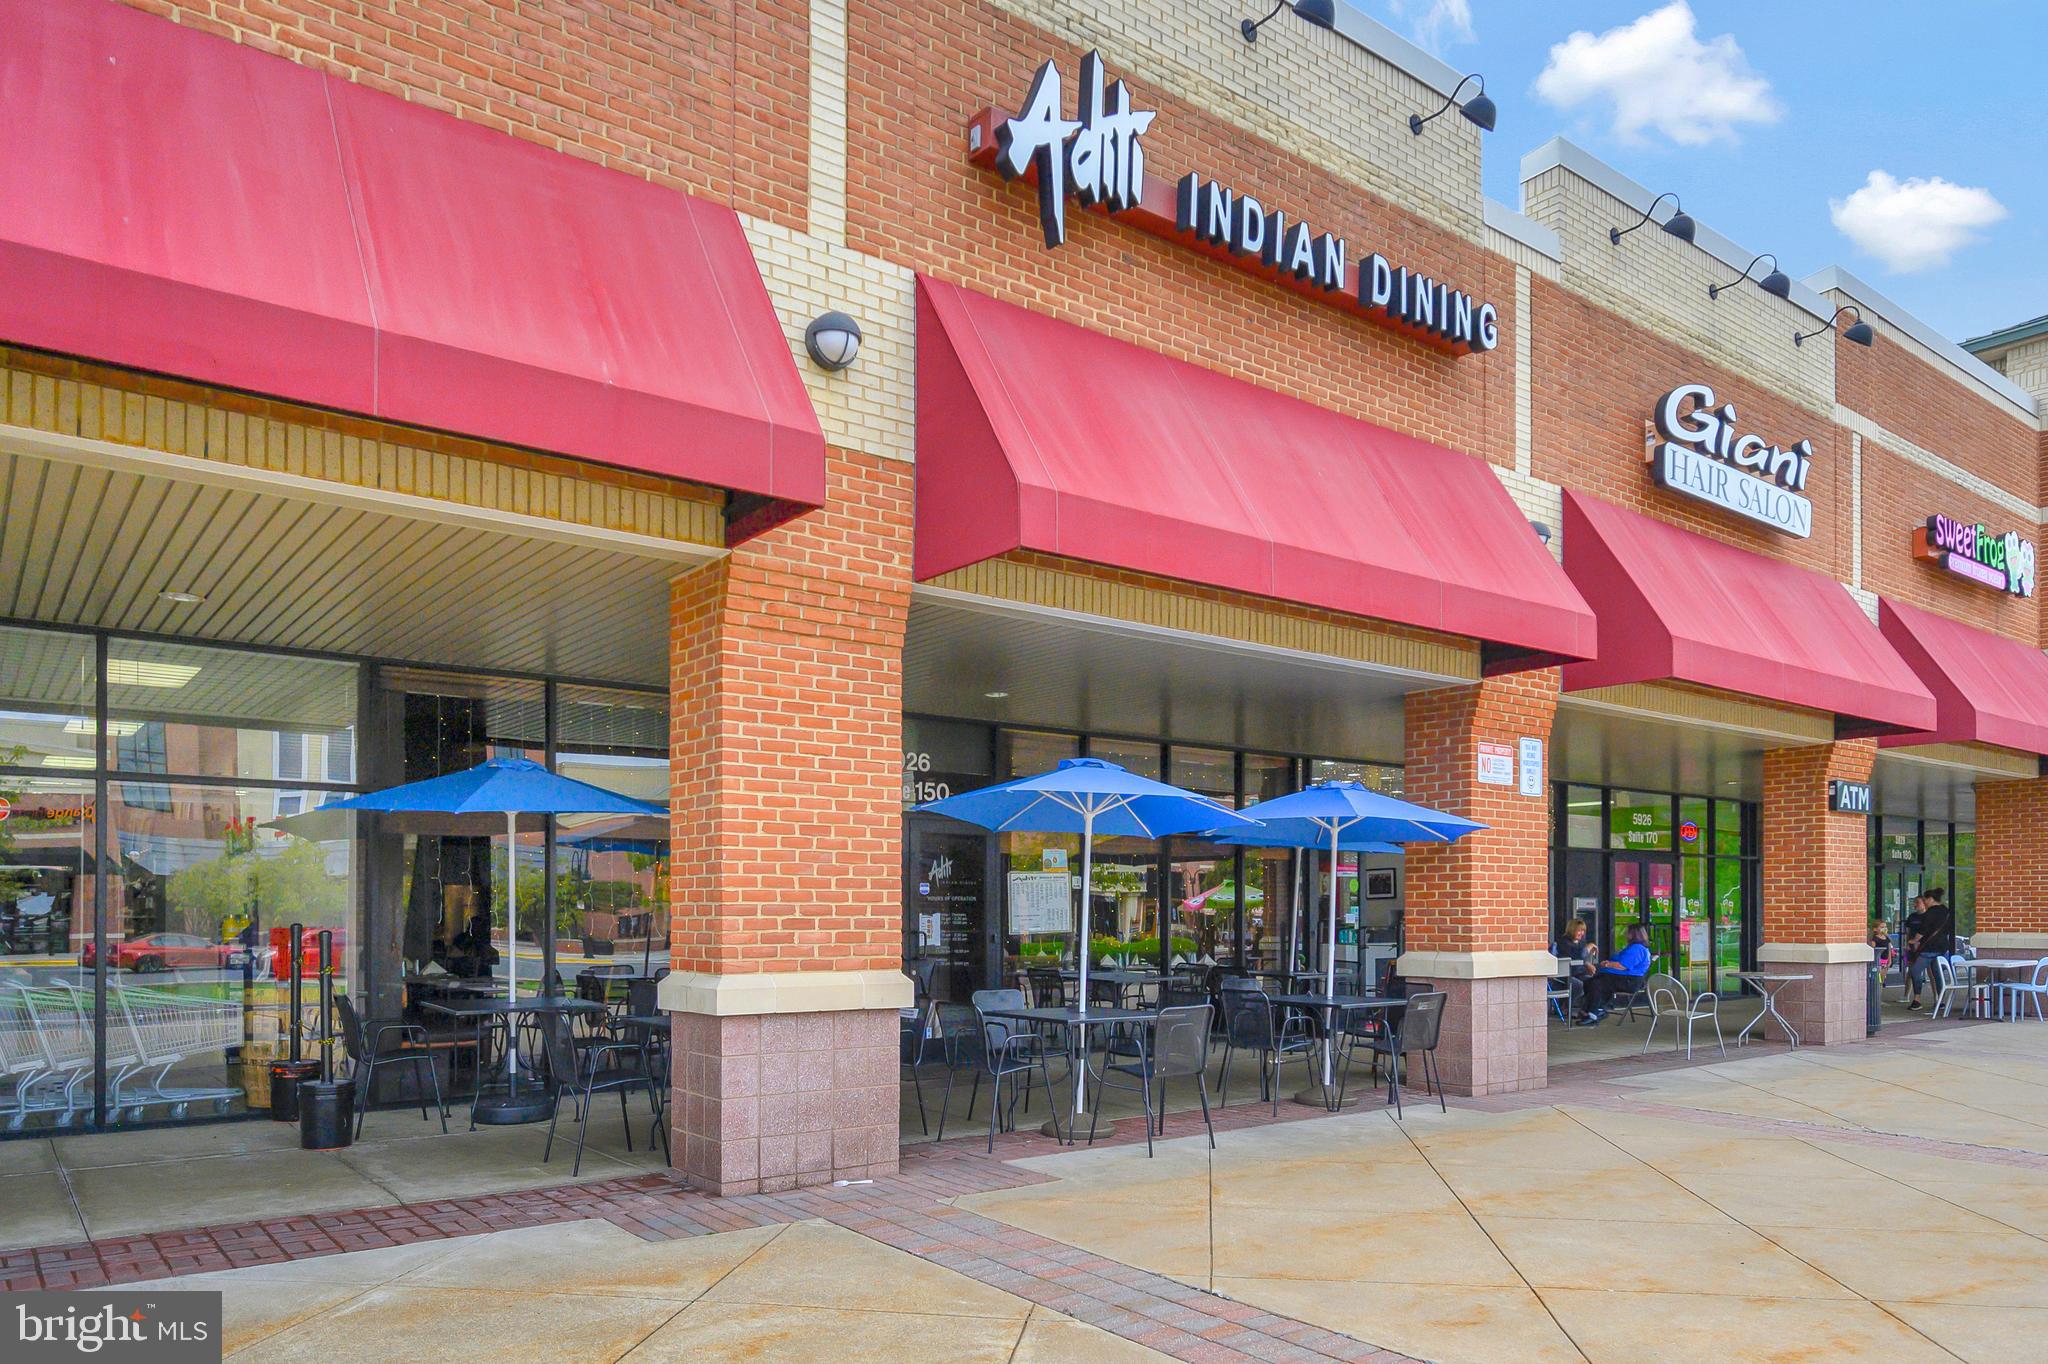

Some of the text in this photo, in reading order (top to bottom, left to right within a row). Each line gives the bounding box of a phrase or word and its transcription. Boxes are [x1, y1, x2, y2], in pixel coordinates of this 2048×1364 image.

[1188, 171, 1498, 350] INDIAN DINING
[1664, 384, 1813, 491] Giani
[1670, 449, 1807, 532] HAIR SALON
[1481, 757, 1491, 773] NO
[915, 781, 950, 801] 150
[1840, 785, 1869, 811] ATM
[1633, 813, 1652, 826] 5926
[1628, 831, 1658, 844] Suite 170
